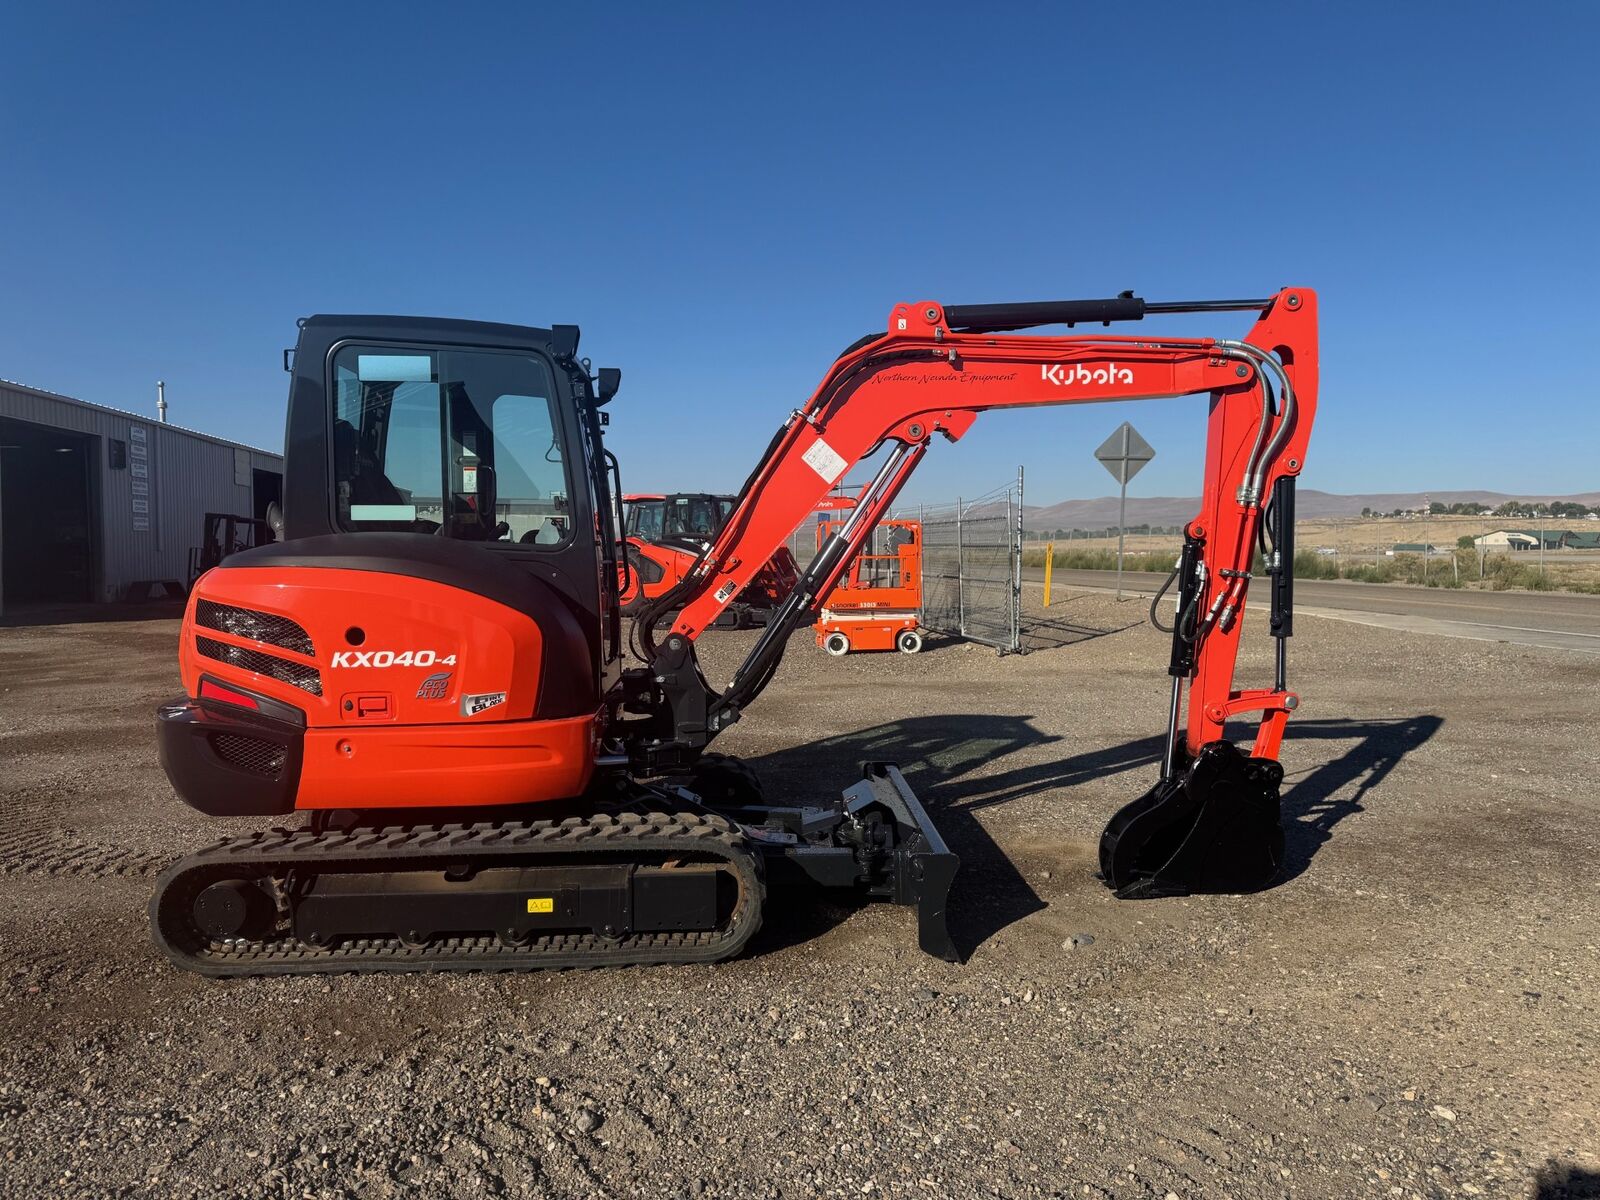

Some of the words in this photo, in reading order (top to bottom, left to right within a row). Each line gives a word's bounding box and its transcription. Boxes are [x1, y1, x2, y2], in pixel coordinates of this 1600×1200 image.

[871, 372, 919, 384] Northern
[918, 372, 958, 385] Nevada
[960, 371, 1016, 384] Equipment
[1041, 363, 1133, 385] Kubota
[331, 650, 457, 668] KX040-4
[424, 680, 448, 689] eco
[416, 688, 446, 699] PLUS
